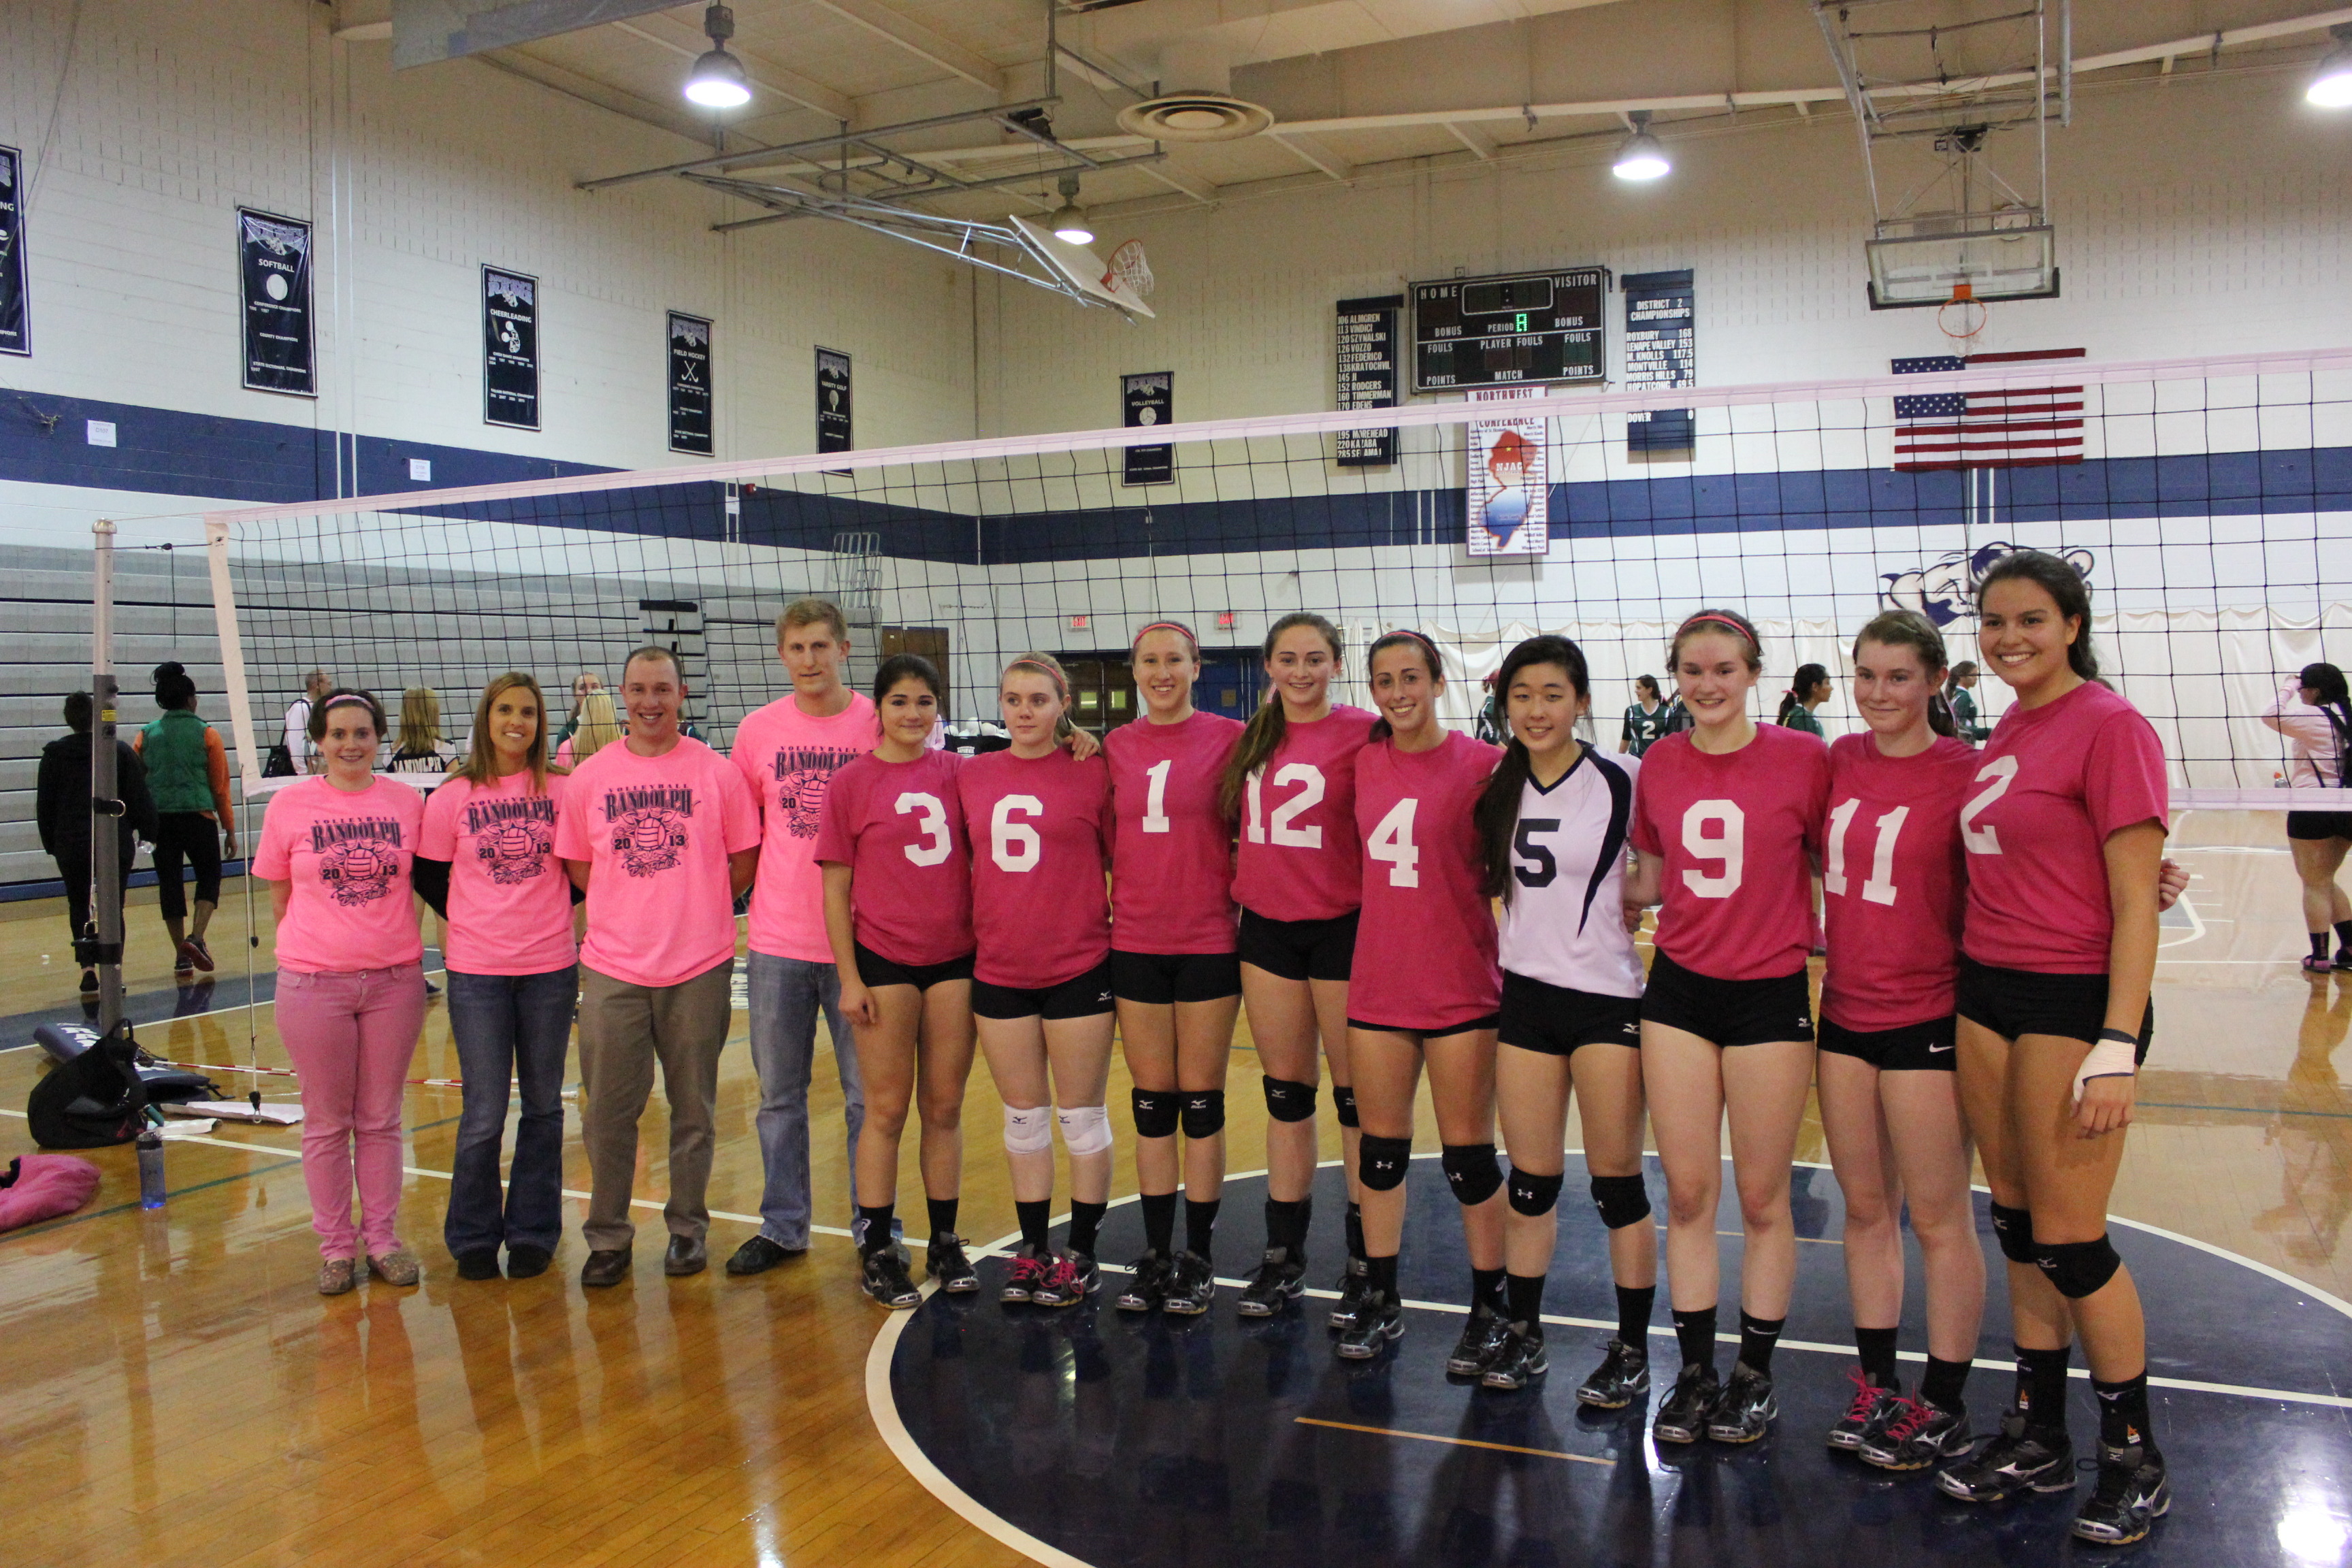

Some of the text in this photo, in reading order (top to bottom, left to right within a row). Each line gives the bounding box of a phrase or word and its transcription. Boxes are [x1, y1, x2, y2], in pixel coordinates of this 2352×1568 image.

[259, 259, 295, 272] SOFTBALL
[1554, 274, 1597, 288] VISITOR
[1421, 286, 1458, 299] HOME
[1637, 298, 1682, 310] DISTRICT 2
[490, 309, 532, 323] CHEERLEADING
[1338, 313, 1380, 325] 106 ALMGREN
[1631, 308, 1690, 321] CHAMPIONSHIPS
[1338, 323, 1373, 333] 113 VINDICI
[1488, 323, 1514, 332] PERIOD
[1555, 316, 1583, 327] BONUS
[1338, 332, 1386, 344] 120 SZYNALSKI
[1435, 326, 1462, 337] BONUS
[1565, 333, 1591, 343] FOULS
[1627, 328, 1692, 342] ROXBURY 168
[1338, 343, 1371, 353] 126 VOZZO
[1428, 343, 1453, 353] FOULS
[1480, 336, 1543, 350] PLAYER FOULS
[1627, 338, 1693, 352] LENAPE VALLEY 153
[674, 348, 706, 361] FIELD HOCKEY
[1339, 352, 1382, 363] 132 FEDERICO
[1636, 350, 1664, 361] KNOLLS
[1673, 348, 1693, 359] 117.5
[1339, 361, 1391, 372] 138 KRATOCHVIL
[1563, 365, 1594, 376] POINTS
[1627, 359, 1693, 372] MONTVILLE 114
[1338, 373, 1350, 382] 145
[1426, 375, 1456, 386] POINTS
[1494, 370, 1522, 380] MATCH
[1627, 369, 1693, 382] MORRIS HILLS 79
[1338, 380, 1382, 392] 152 RODGERS
[1627, 379, 1693, 392] HOPATCONG 695
[1338, 390, 1392, 402] 160 TIMMERMAN
[1476, 389, 1533, 402] NORTHWEST
[1338, 400, 1373, 410] 170 EDENS
[1688, 410, 1694, 420] 0
[1338, 430, 1350, 440] 195
[1338, 440, 1350, 449] 220
[1338, 450, 1350, 458] 285
[1497, 461, 1522, 471] NJAC
[1073, 617, 1085, 627] EXIT
[1642, 721, 1656, 739] 2
[775, 751, 862, 781] RANDOLP
[609, 784, 687, 792] VOLLEYBALL
[470, 796, 547, 806] VOLLEYBALL
[782, 798, 796, 808] 20
[1143, 760, 1170, 833] 1
[604, 789, 693, 823] RANDOLPH
[1247, 763, 1326, 849] 12
[1961, 755, 2019, 855] 2
[314, 817, 395, 825] VOLLEYBALL
[468, 799, 555, 834] RANDOLPH
[894, 792, 951, 867] 3
[991, 794, 1043, 872] 6
[310, 821, 402, 853] RANDOLPH
[615, 835, 685, 849] 20 13
[1367, 798, 1419, 888] 4
[479, 842, 550, 858] 20 13
[1514, 818, 1560, 888] 5
[1682, 799, 1745, 898] 9
[1825, 798, 1909, 906] 11
[323, 864, 397, 879] 20 13
